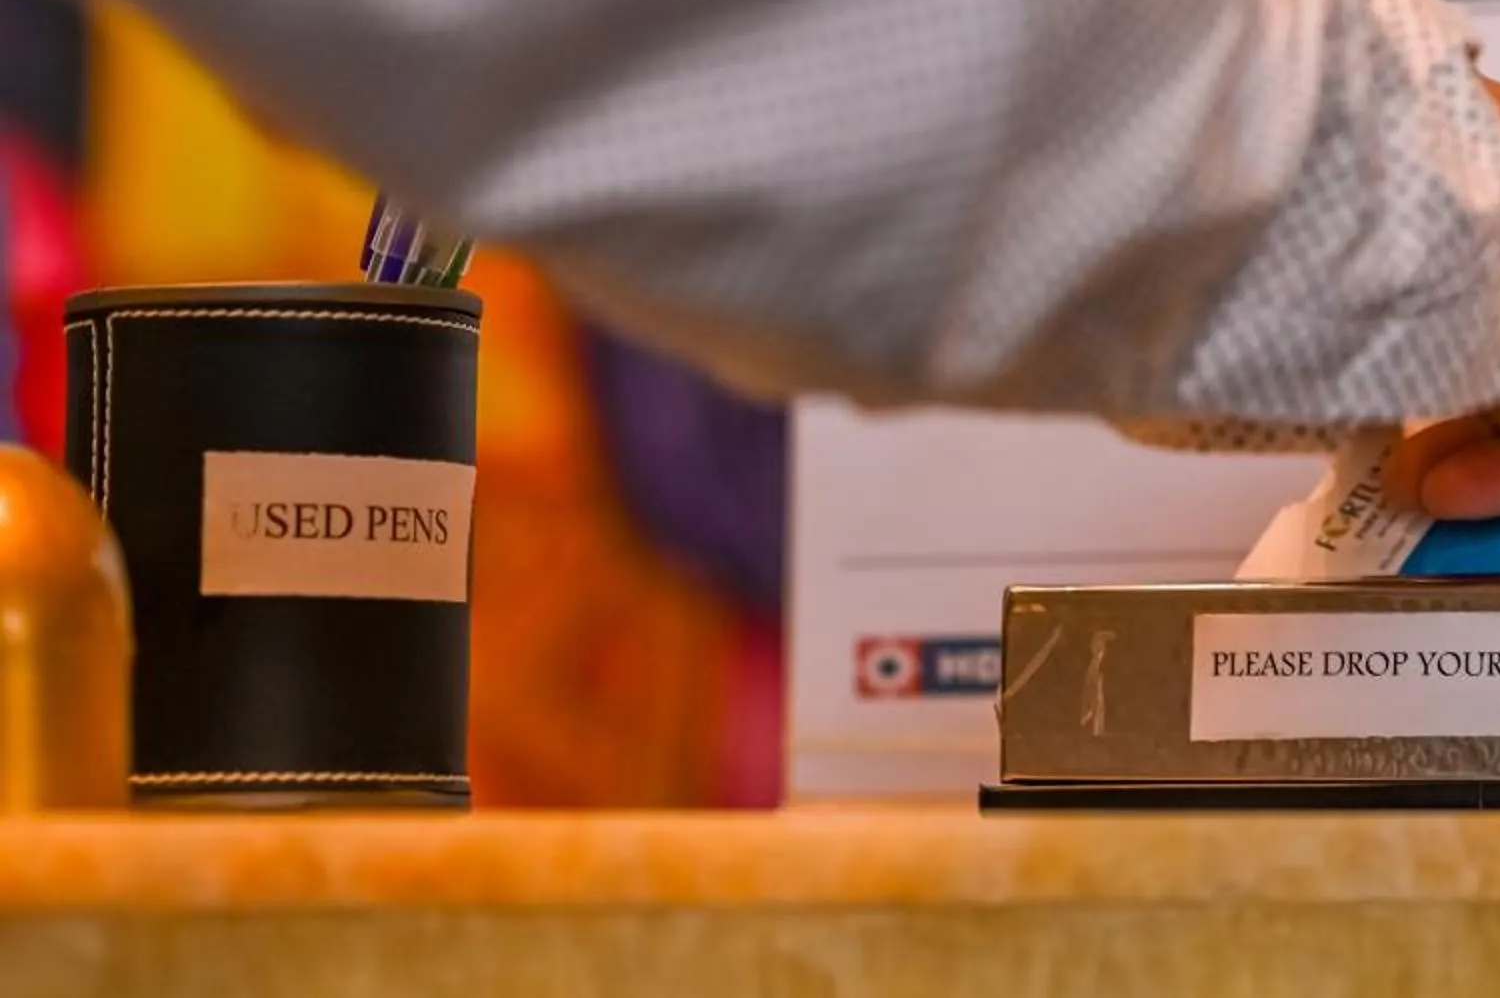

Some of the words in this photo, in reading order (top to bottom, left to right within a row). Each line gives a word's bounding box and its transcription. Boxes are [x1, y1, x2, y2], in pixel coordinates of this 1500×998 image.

[230, 502, 353, 540] USED
[366, 505, 449, 545] PENS
[1211, 650, 1313, 677] PLEASE
[1321, 650, 1408, 677] DROP
